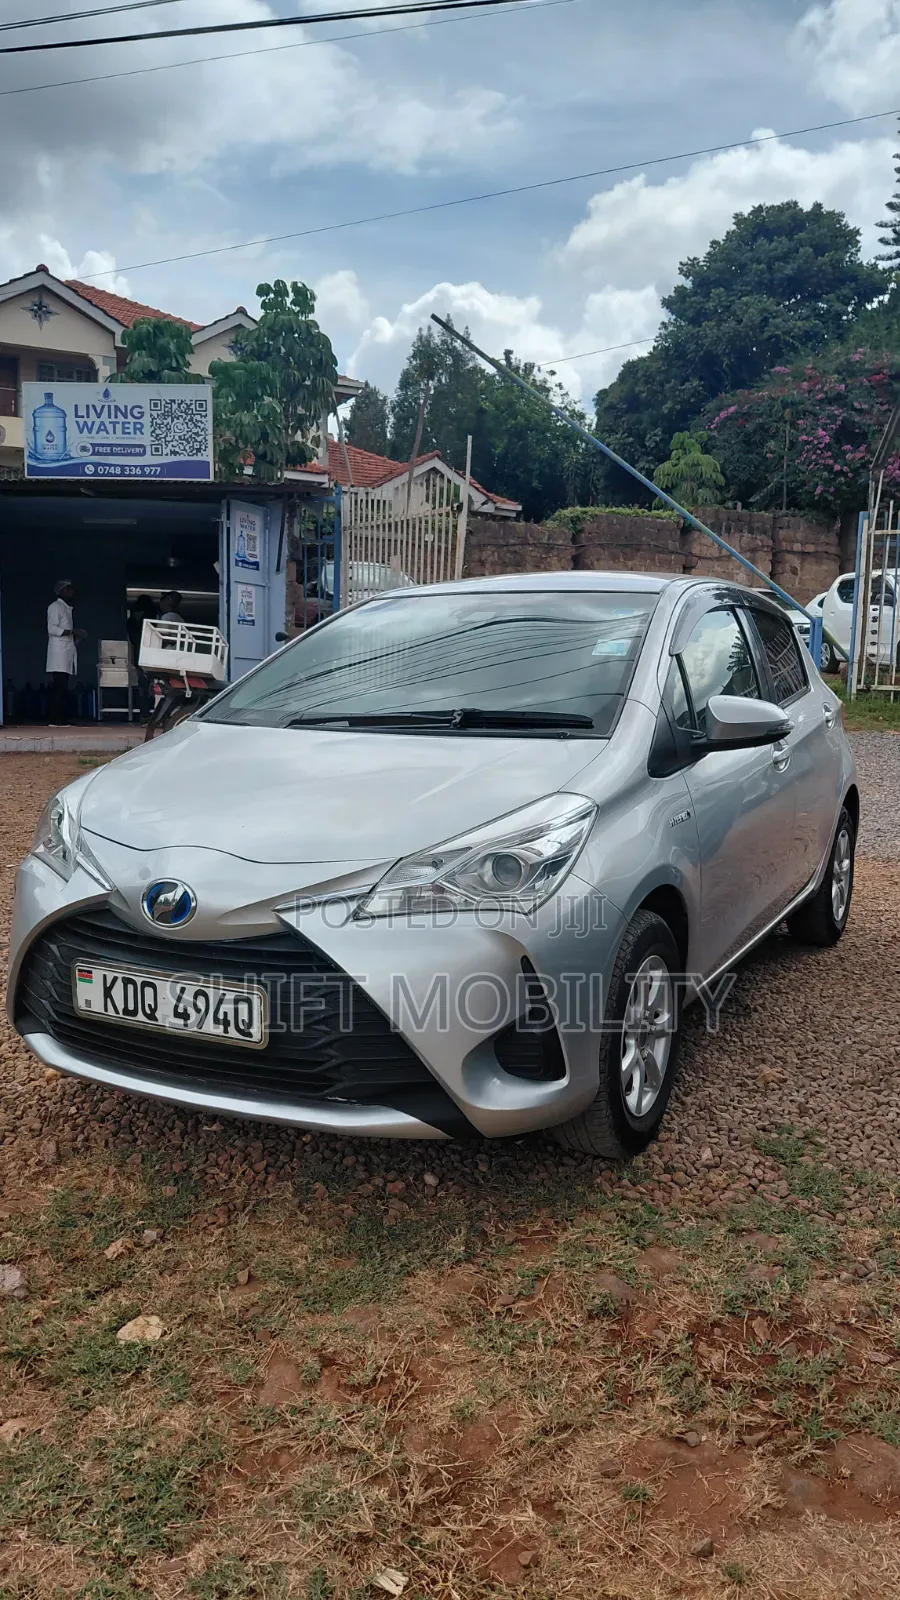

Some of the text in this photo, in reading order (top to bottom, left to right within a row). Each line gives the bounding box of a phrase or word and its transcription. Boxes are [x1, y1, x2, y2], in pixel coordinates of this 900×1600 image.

[74, 403, 145, 420] LIVING
[75, 420, 145, 436] WATER
[112, 446, 144, 454] DELIVERY
[97, 466, 161, 476] 0748 336 977
[103, 973, 159, 1022] KDQ
[173, 986, 254, 1038] 494Q
